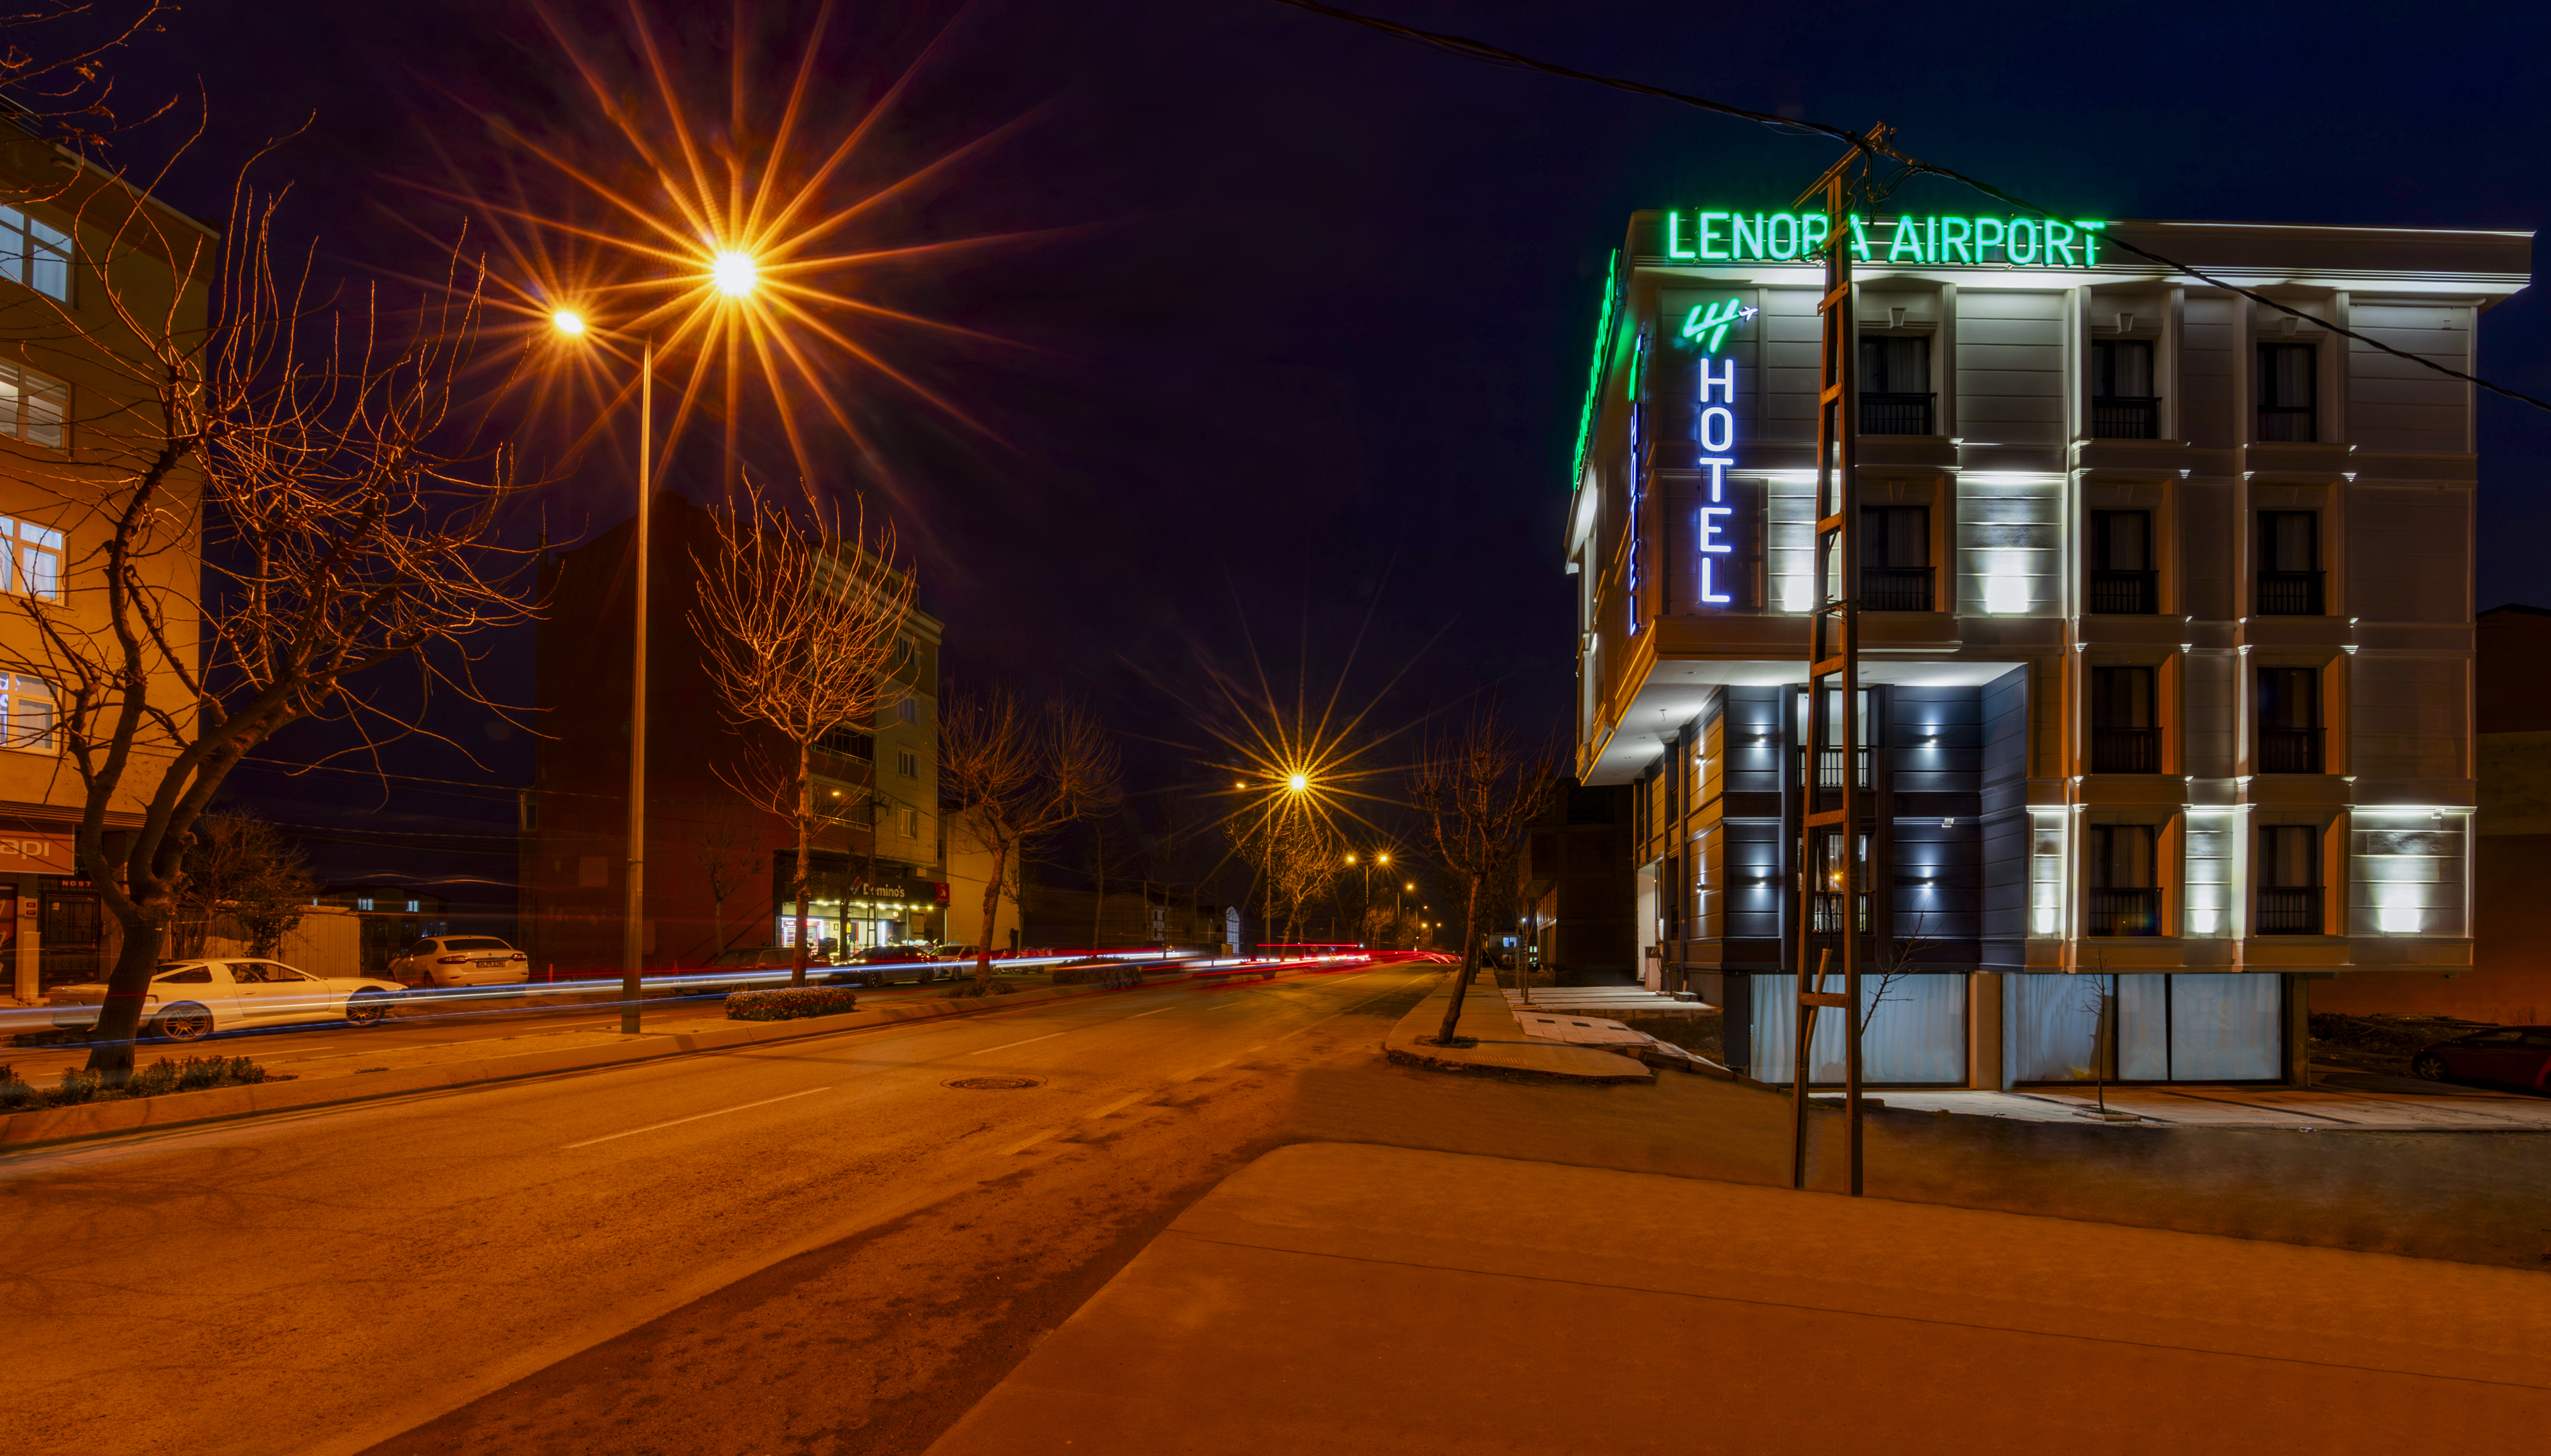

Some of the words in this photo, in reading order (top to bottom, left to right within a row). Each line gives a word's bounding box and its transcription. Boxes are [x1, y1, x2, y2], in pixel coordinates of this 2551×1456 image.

[1590, 247, 1616, 410] AIRPORT
[1669, 212, 1871, 261] LENORA
[1888, 215, 2105, 267] AIRPORT
[1629, 402, 1638, 637] HOTEL
[1699, 358, 1734, 603] HOTEL
